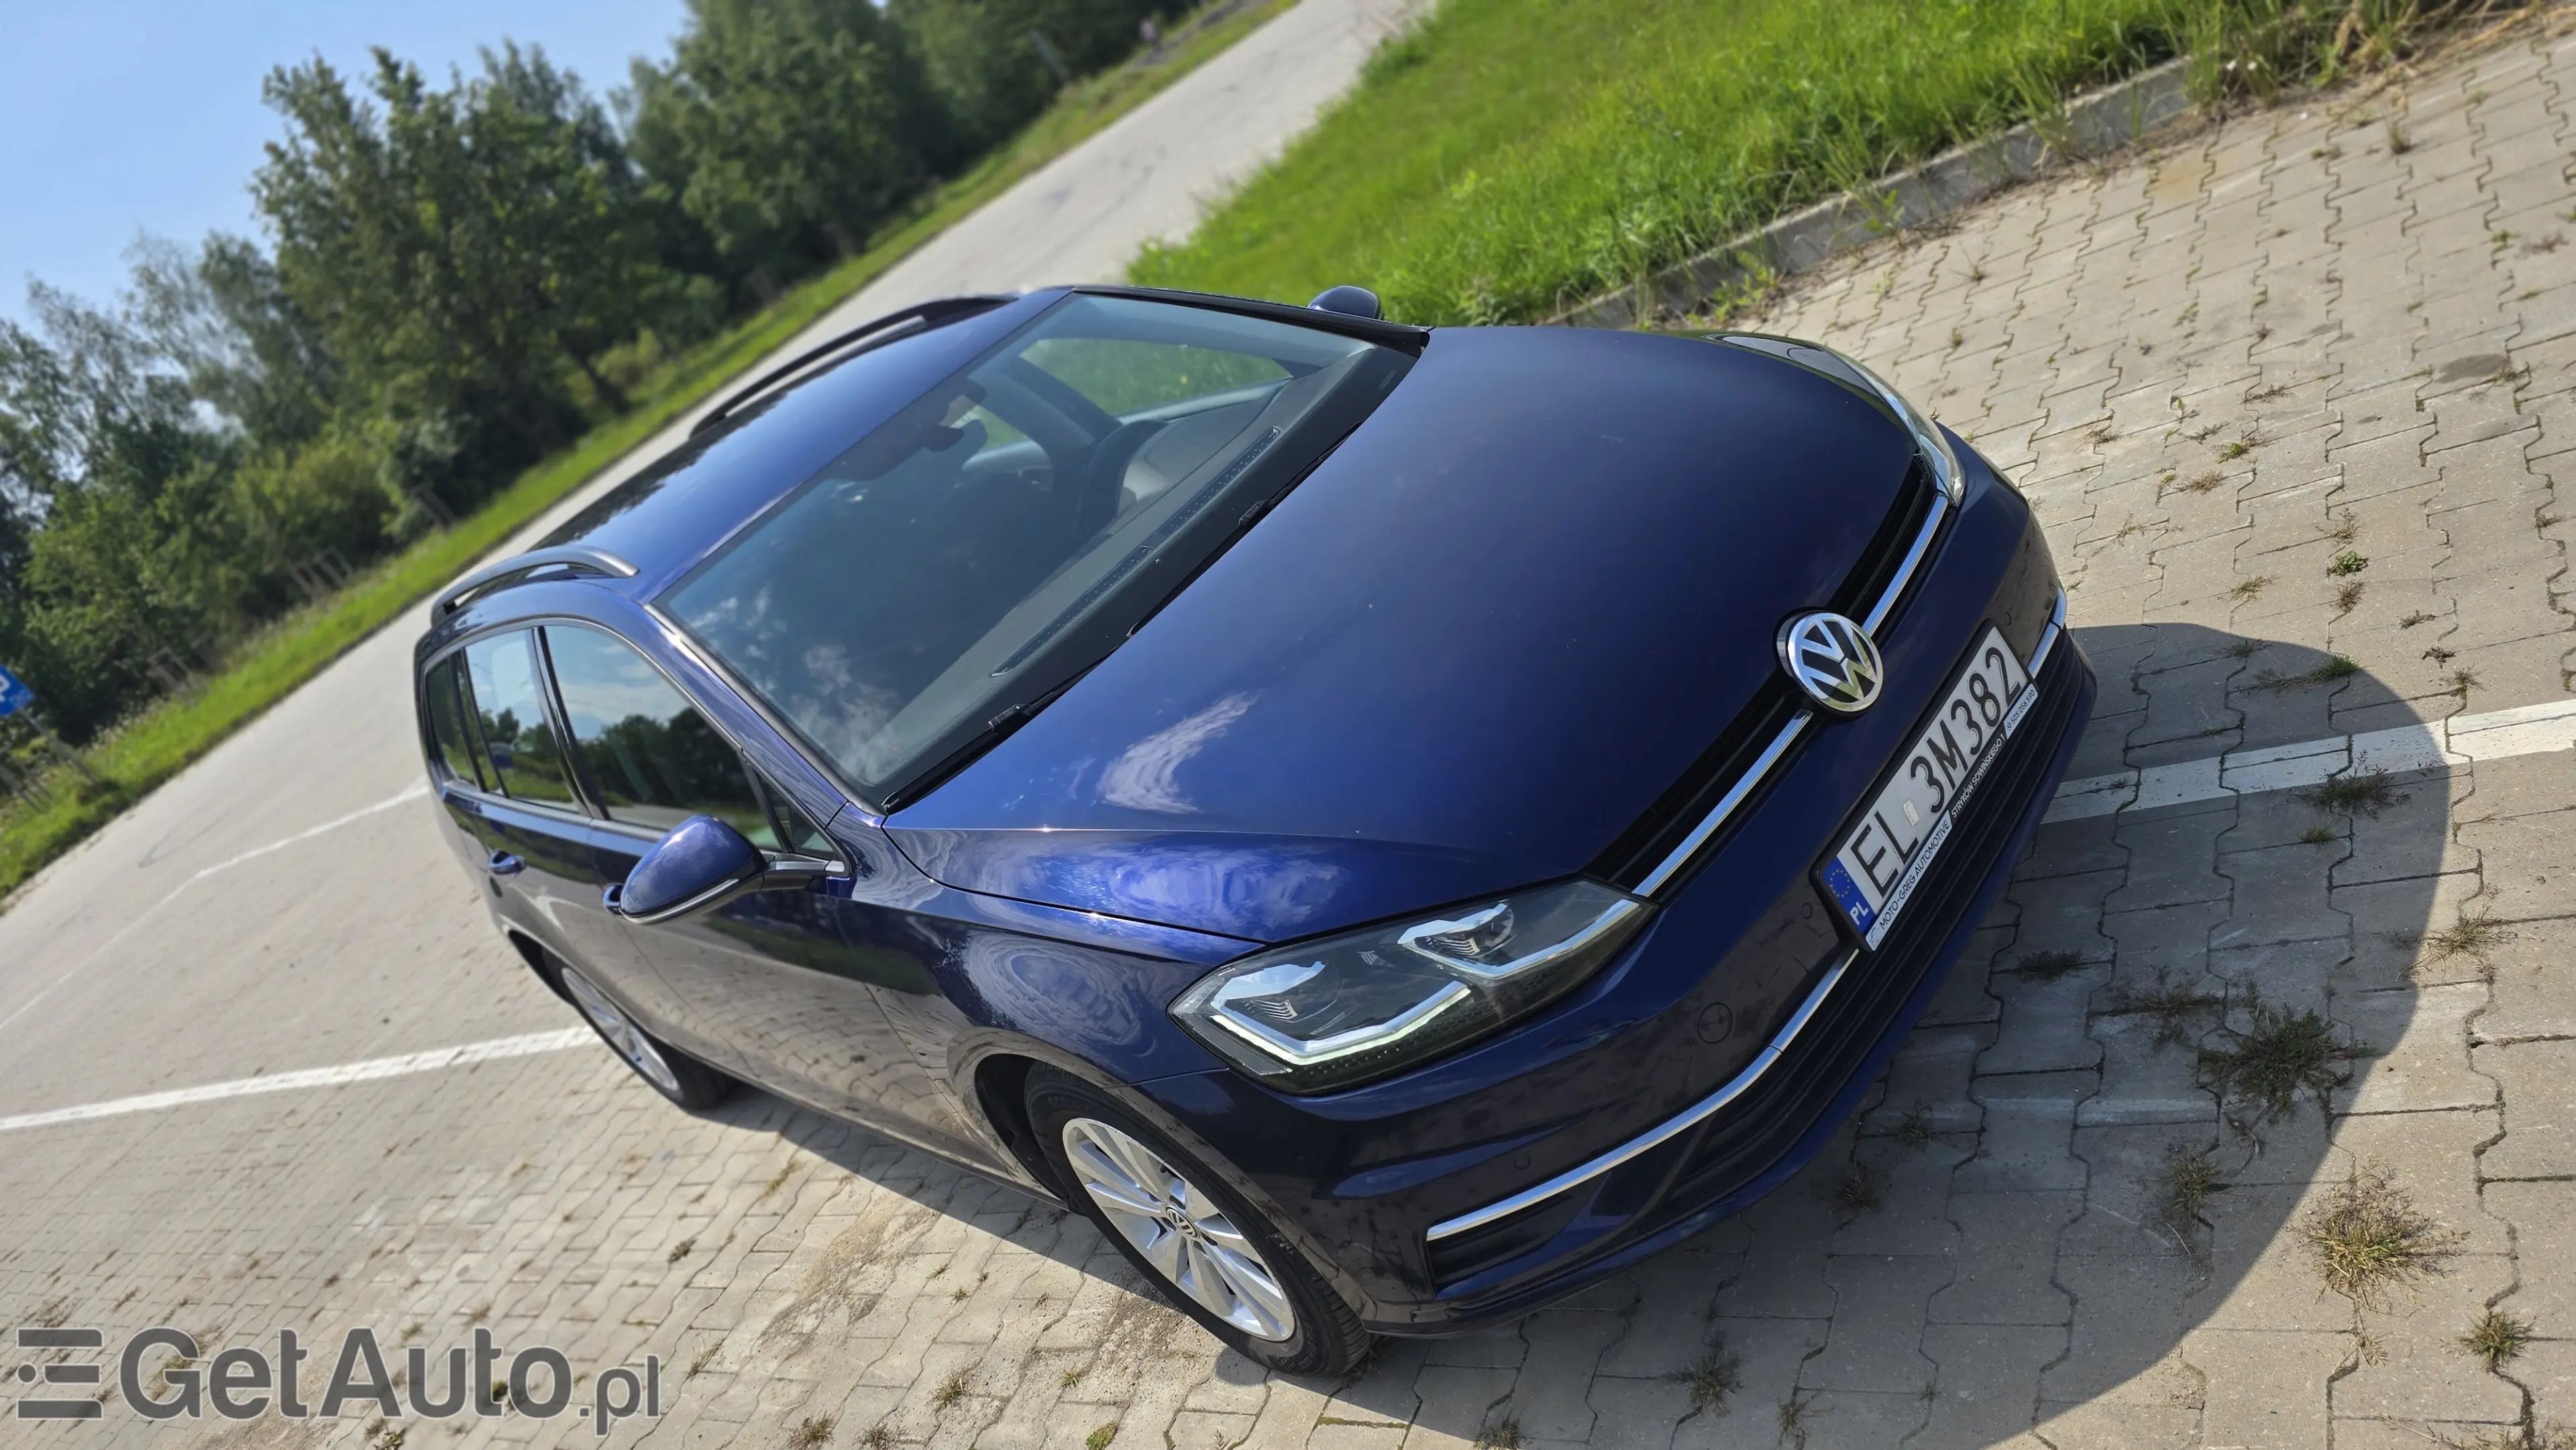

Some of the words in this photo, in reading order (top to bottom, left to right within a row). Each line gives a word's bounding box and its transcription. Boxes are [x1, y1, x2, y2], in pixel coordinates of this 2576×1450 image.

[1849, 810, 1919, 899] EL
[1909, 647, 2022, 814] 3M382
[1951, 783, 1974, 818] STRYKÓW
[1880, 874, 1916, 930] MOTO-GREG
[1915, 819, 1950, 877] AUTOMOTIVE
[1849, 901, 1869, 926] PL
